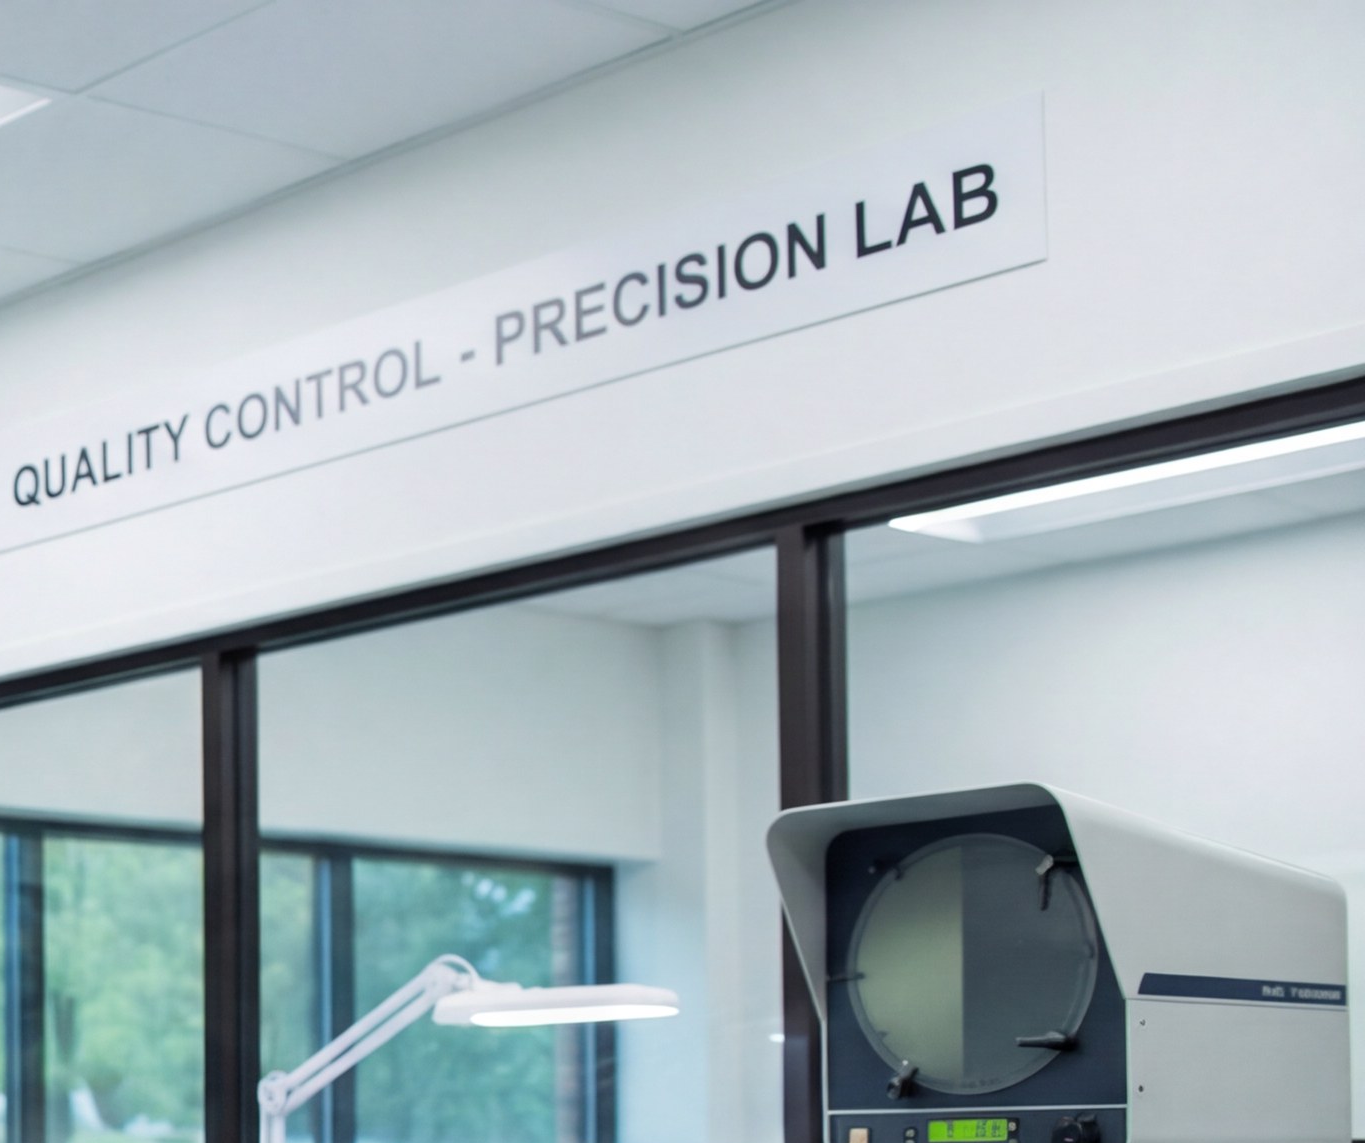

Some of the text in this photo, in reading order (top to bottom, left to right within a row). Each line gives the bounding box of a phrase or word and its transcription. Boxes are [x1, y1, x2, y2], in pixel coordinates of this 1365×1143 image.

[11, 162, 1000, 508] QUALITY CONTROL - PRECISION LAB
